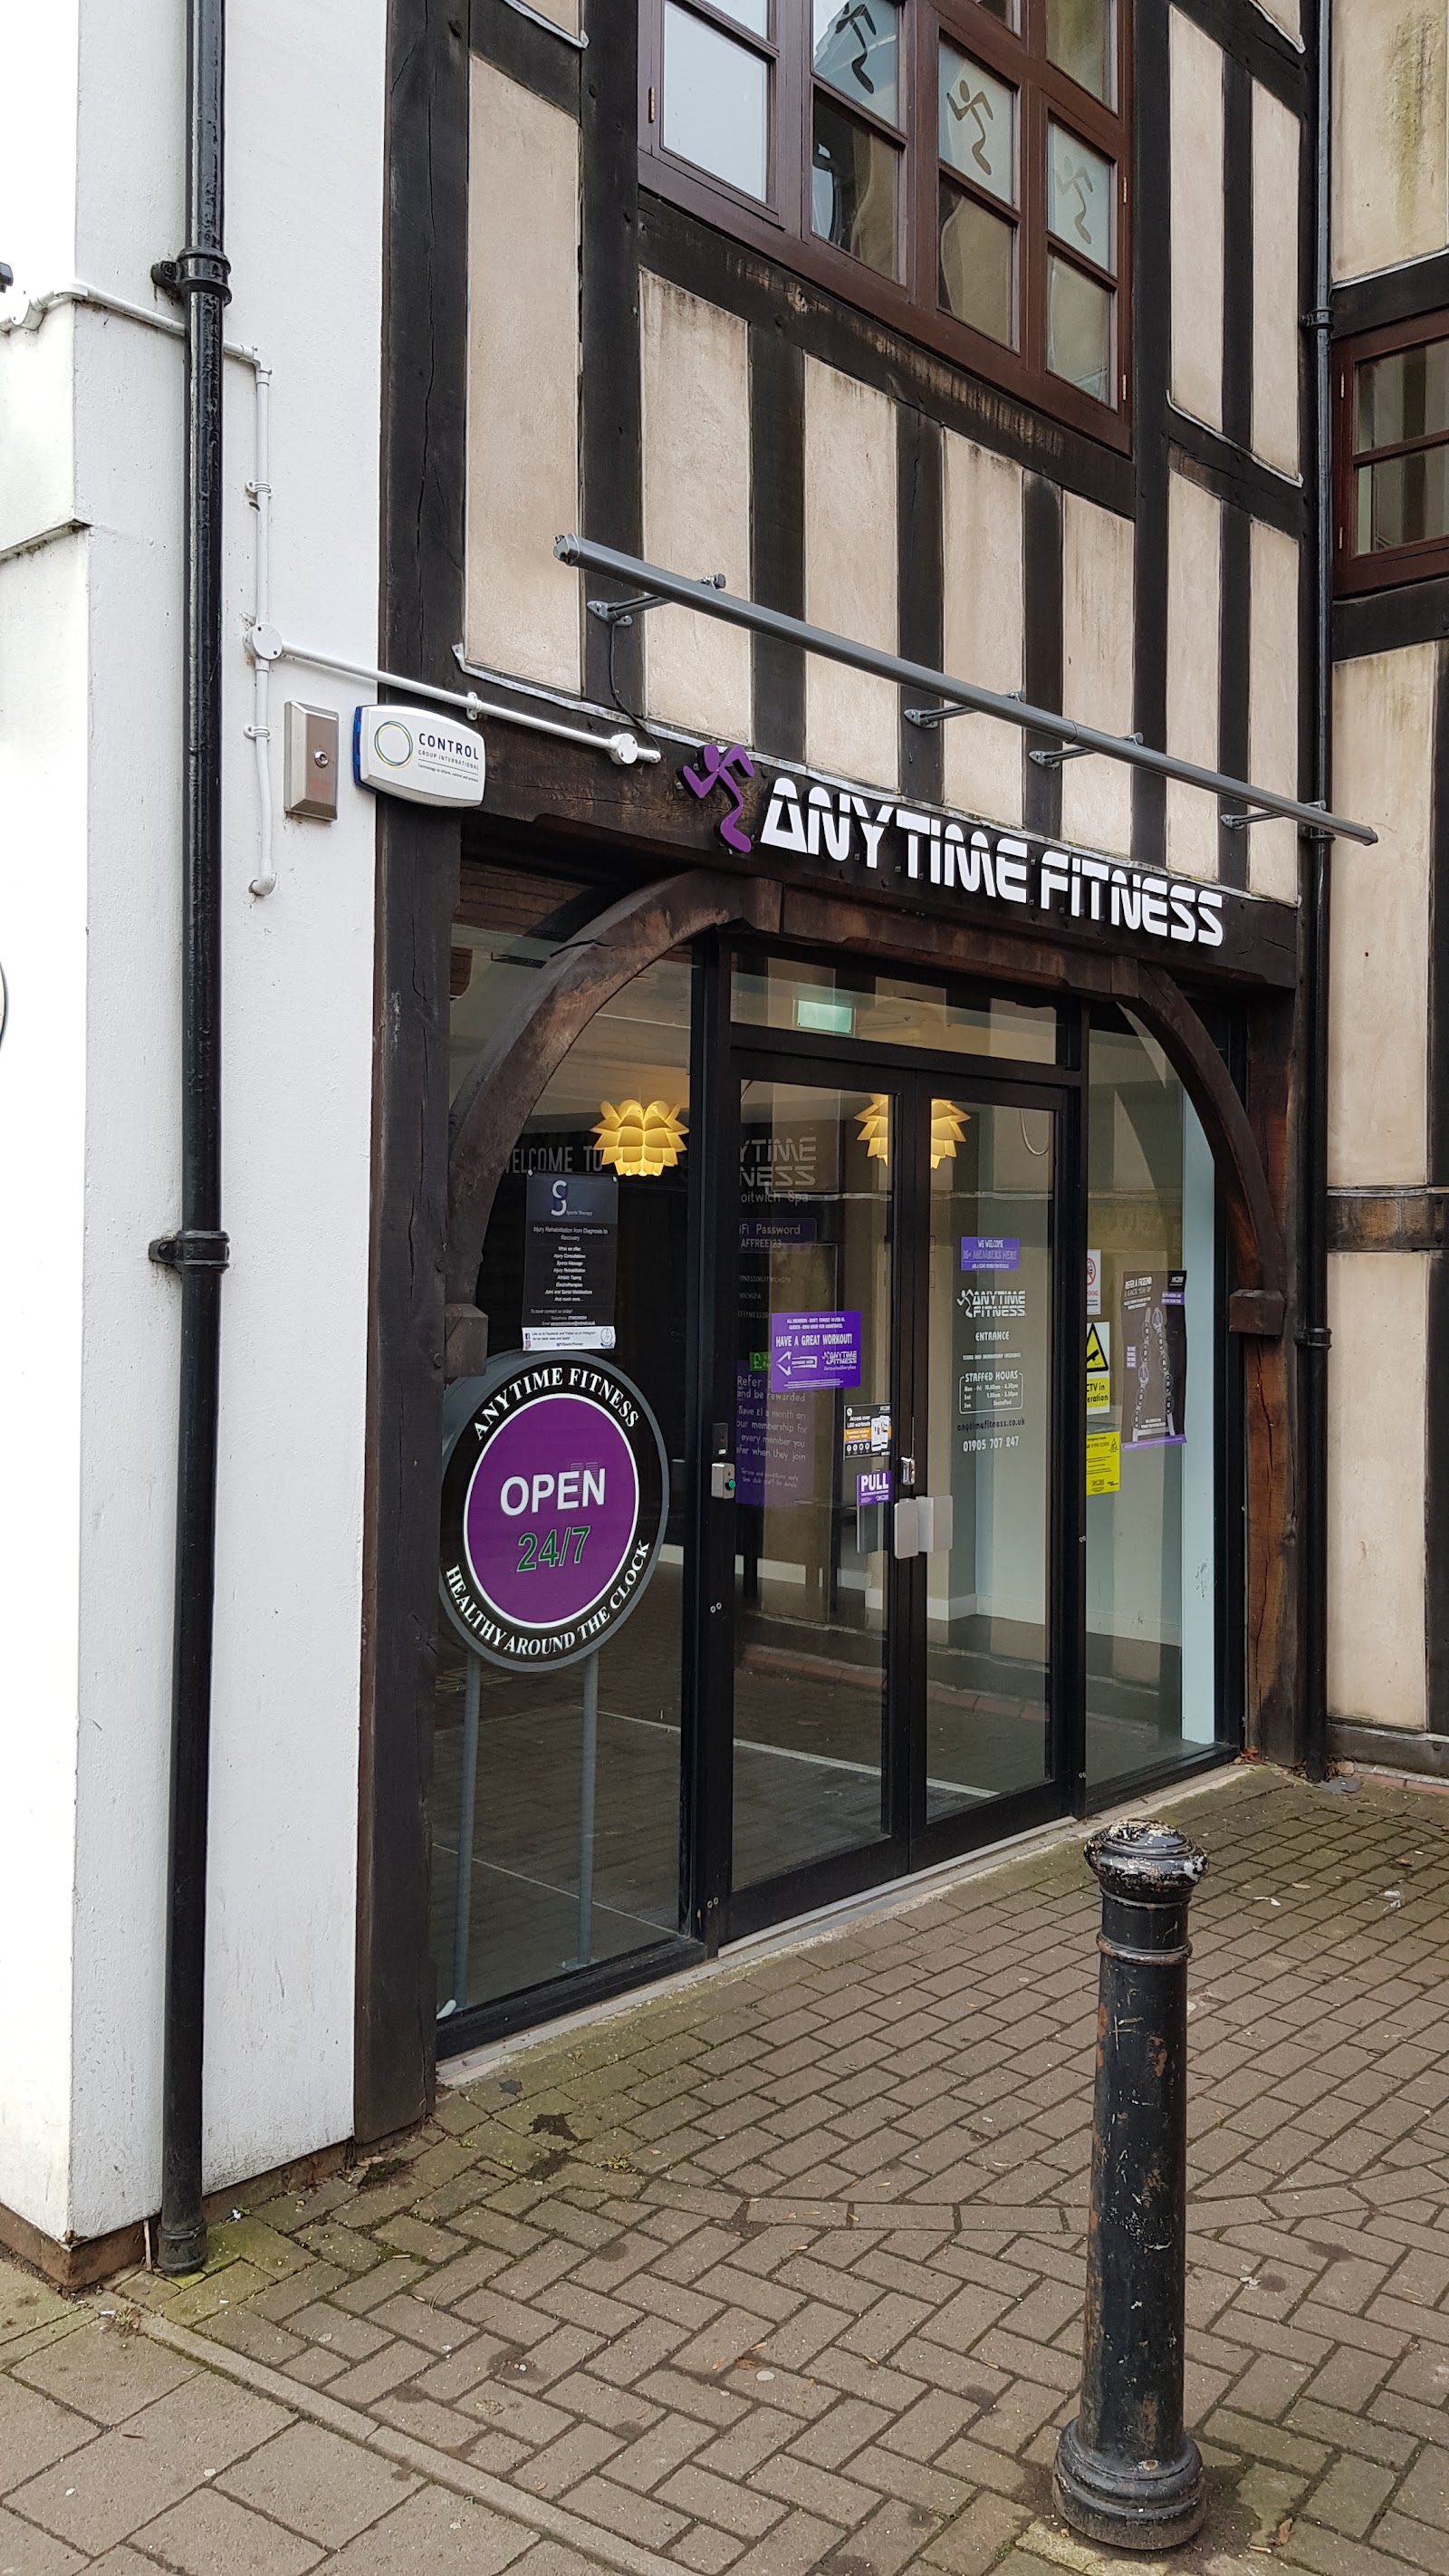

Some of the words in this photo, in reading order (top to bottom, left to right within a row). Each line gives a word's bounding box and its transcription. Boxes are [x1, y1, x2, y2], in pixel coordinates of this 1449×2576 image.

[418, 733, 479, 760] CONTROL
[417, 749, 437, 758] GROUP
[438, 755, 479, 771] INTERNATIONAL
[760, 777, 1028, 904] ANYTIME
[1041, 850, 1223, 947] FITNESS
[740, 1137, 816, 1162] YTIME
[740, 1166, 815, 1187] NESS
[741, 1190, 781, 1203] oitwich
[788, 1190, 809, 1206] Spa
[739, 1224, 750, 1235] iFi
[755, 1224, 801, 1235] Password
[978, 1239, 984, 1248] WE
[985, 1239, 1004, 1248] WELCOME
[973, 1250, 1002, 1260] MEMBERS
[1003, 1251, 1017, 1260] HERE
[973, 1291, 1026, 1305] ANYTIME
[973, 1305, 1026, 1317] FITNESS
[776, 1336, 792, 1347] HAVE
[794, 1335, 799, 1346] A
[801, 1334, 820, 1346] GREAT
[822, 1333, 852, 1345] WORKOUT!
[975, 1331, 1010, 1341] ENTRANCE
[830, 1350, 857, 1359] ANYTIME
[736, 1374, 762, 1388] Refer
[964, 1371, 993, 1382] STAFFED
[995, 1370, 1018, 1380] HOURS
[1087, 1382, 1098, 1392] CTV
[1099, 1382, 1106, 1391] in
[736, 1389, 752, 1399] and
[754, 1389, 763, 1399] be
[767, 1392, 806, 1402] rewarded
[1087, 1393, 1108, 1403] eration
[474, 1367, 563, 1441] ANYTIME
[568, 1367, 639, 1428] FITNESS
[738, 1405, 753, 1416] Save
[772, 1408, 794, 1418] month
[796, 1412, 806, 1420] on
[751, 1420, 794, 1433] membership
[797, 1423, 808, 1434] for
[957, 1417, 1025, 1432] anytimefitness.co.uk
[741, 1434, 761, 1444] every
[763, 1436, 792, 1446] member
[792, 1439, 805, 1448] you
[963, 1439, 986, 1452] 01905
[989, 1437, 1003, 1449] 707
[1005, 1436, 1020, 1447] 247
[736, 1446, 748, 1455] efer
[752, 1447, 770, 1456] when
[772, 1449, 789, 1461] they
[792, 1451, 806, 1462] join
[860, 1472, 889, 1493] PULL
[500, 1467, 606, 1516] OPEN
[515, 1525, 590, 1572] 24/7
[446, 1563, 508, 1647] HEALTHY
[504, 1634, 575, 1657] AROUND
[577, 1610, 610, 1641] THE
[609, 1539, 651, 1610] CLOCK
